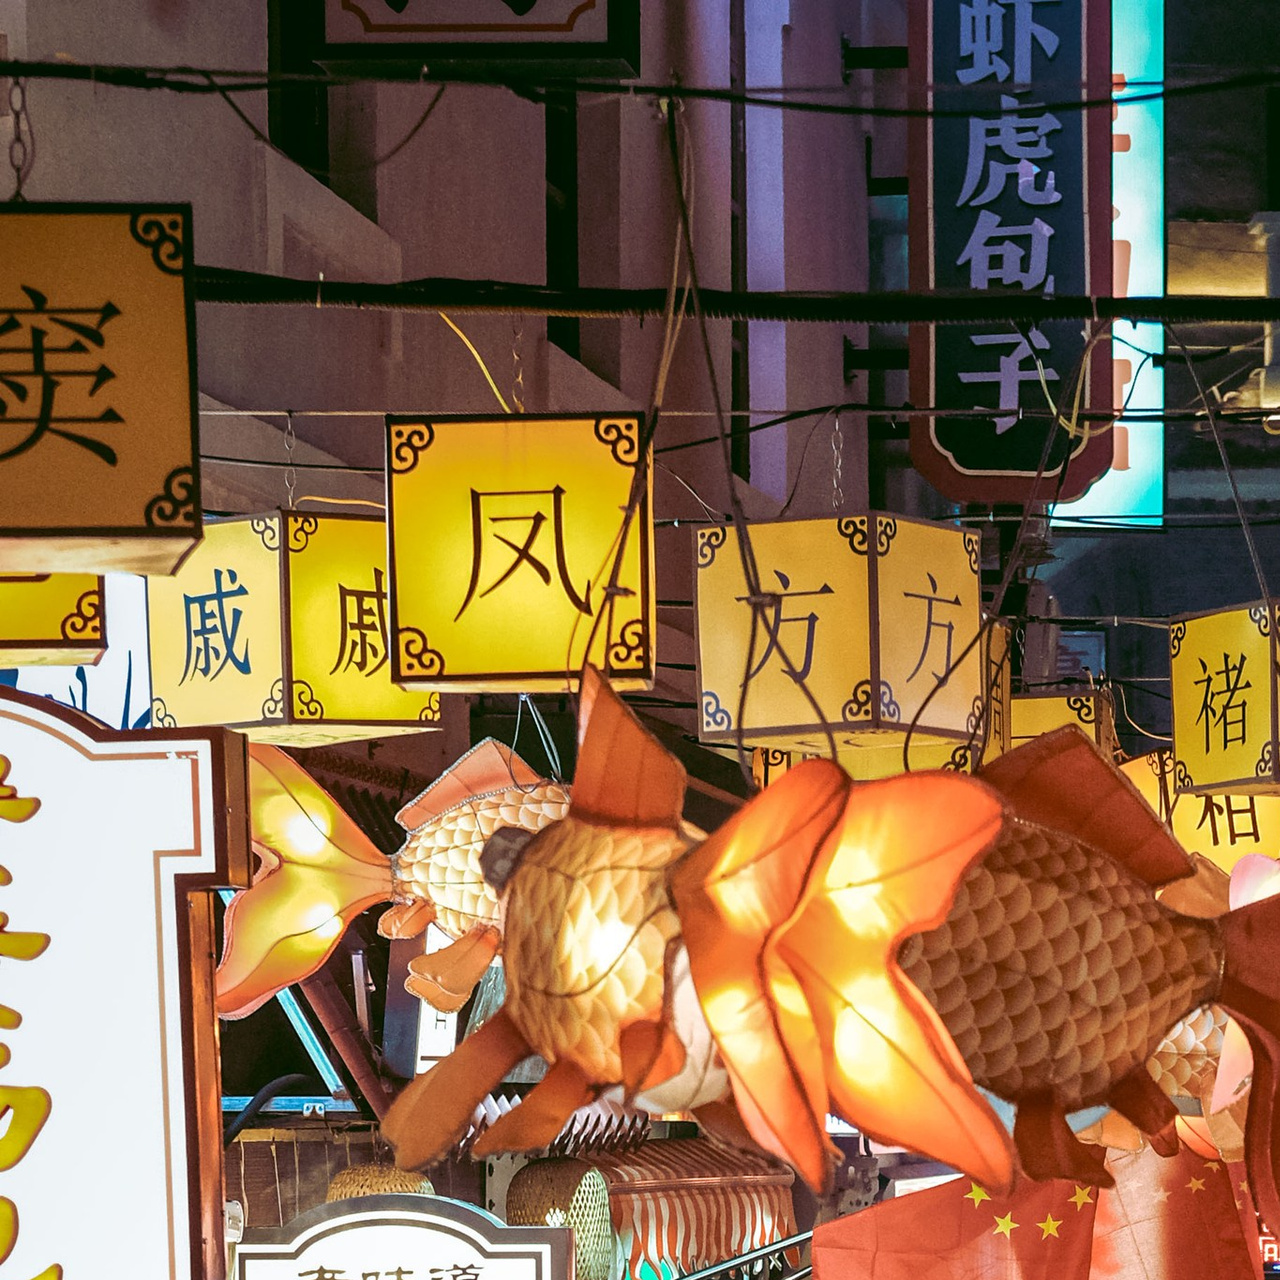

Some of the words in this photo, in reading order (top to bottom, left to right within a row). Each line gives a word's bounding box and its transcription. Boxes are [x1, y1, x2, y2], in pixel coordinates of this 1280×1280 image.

[454, 484, 593, 623] 凤
[178, 568, 253, 686] 戚
[734, 569, 834, 685] 方
[902, 571, 963, 686] 方
[1193, 651, 1253, 755] 褚
